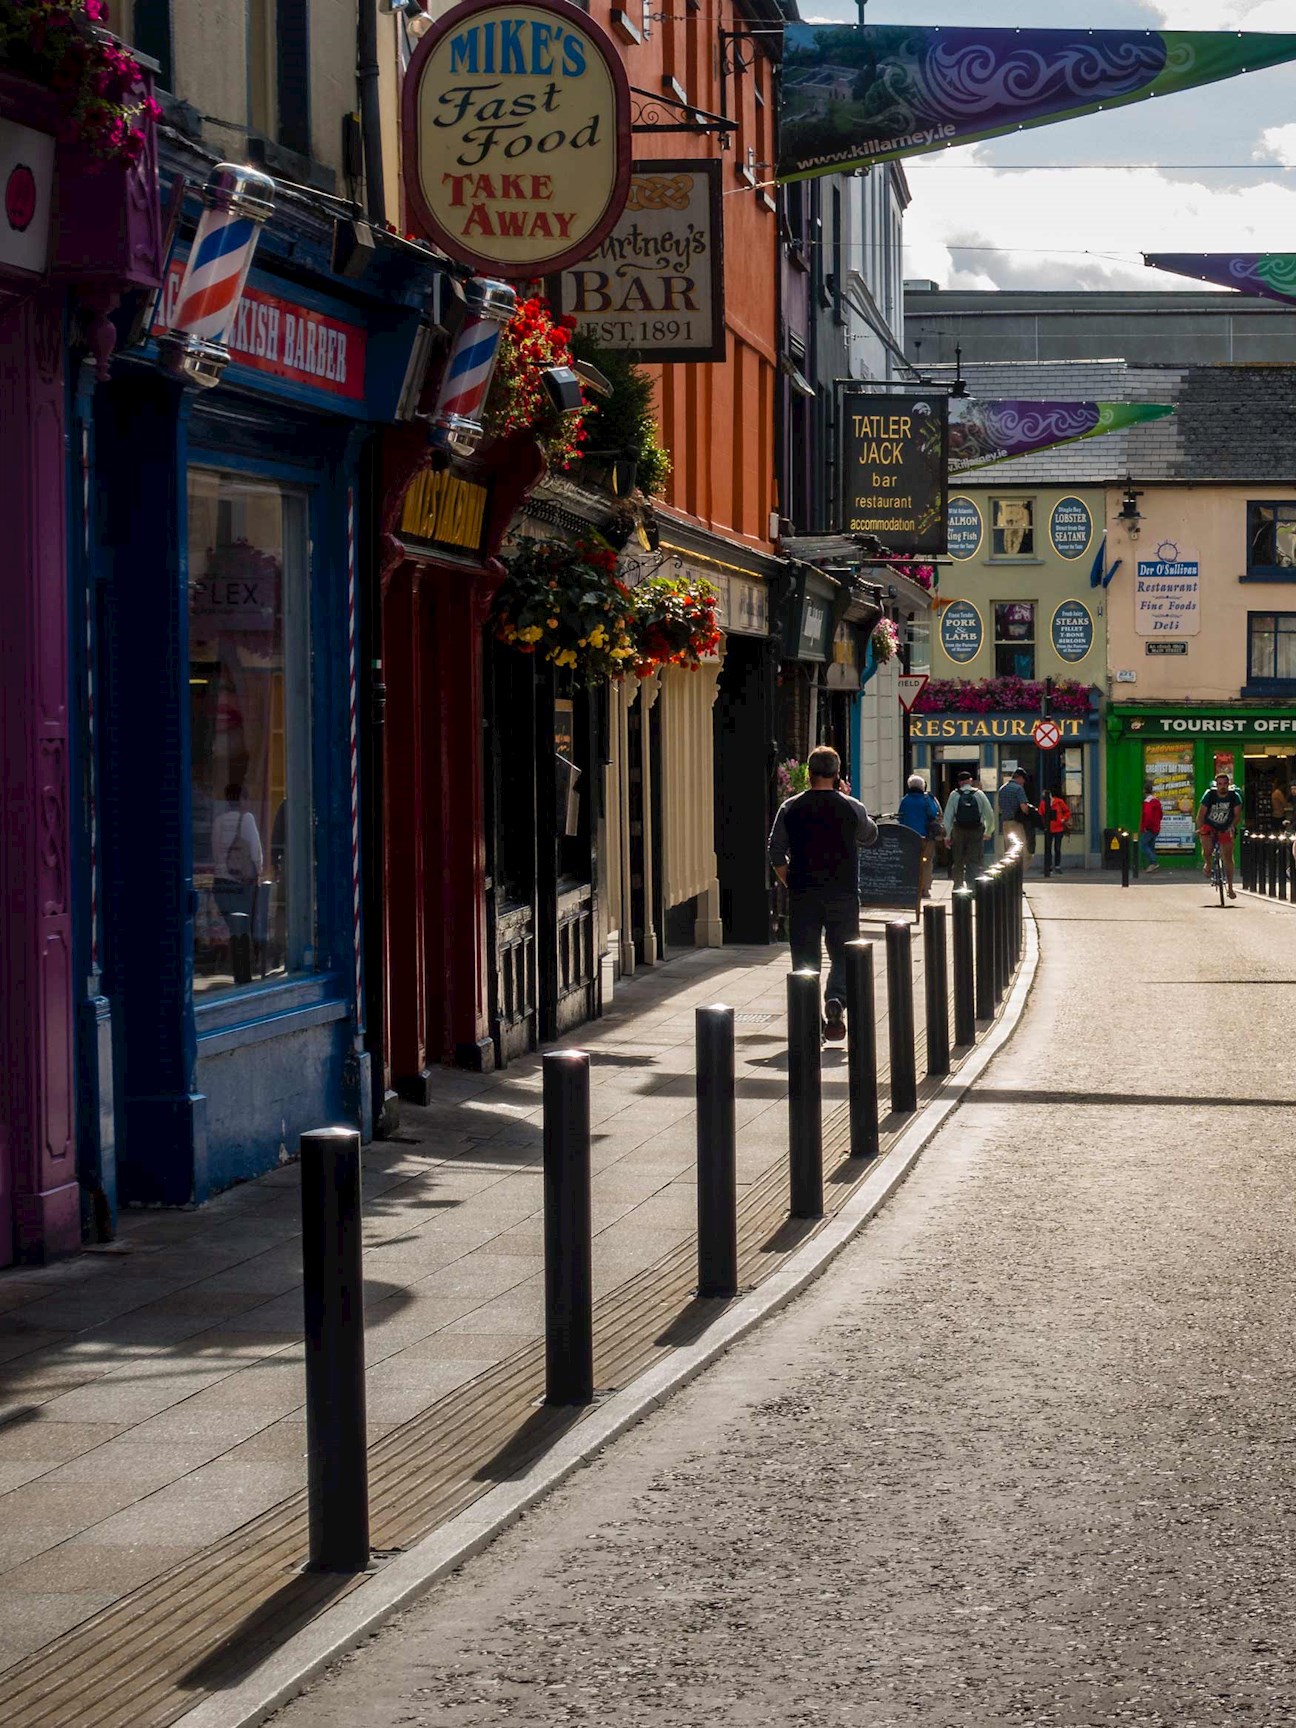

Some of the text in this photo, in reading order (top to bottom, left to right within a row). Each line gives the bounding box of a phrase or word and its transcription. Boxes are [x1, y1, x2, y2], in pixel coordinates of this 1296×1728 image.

[450, 19, 587, 78] MIKE'S
[433, 82, 562, 127] Fast
[456, 115, 601, 166] Food
[796, 123, 956, 170] www.killarney.ie
[442, 172, 553, 207] TAKE
[461, 203, 577, 238] AWAY
[583, 224, 707, 273] urtney's
[568, 270, 701, 313] BAR
[228, 297, 281, 362] KISH
[284, 313, 348, 384] BARBER
[852, 416, 912, 439] TATLER
[859, 442, 904, 465] JACK
[948, 448, 1009, 473] .killarney.ie
[872, 472, 897, 488] bar
[855, 496, 912, 509] restaurant
[850, 516, 915, 532] accommodation
[948, 517, 978, 525] ALMON
[1055, 514, 1087, 523] LOBSTER
[1156, 563, 1197, 576] O'Sullivan
[1137, 581, 1198, 592] Restaurant
[1140, 600, 1196, 610] Fine Foods
[946, 619, 976, 627] PORK
[1056, 617, 1089, 626] STEAKS
[1153, 621, 1179, 630] Deli
[1160, 719, 1247, 731] TOURIST
